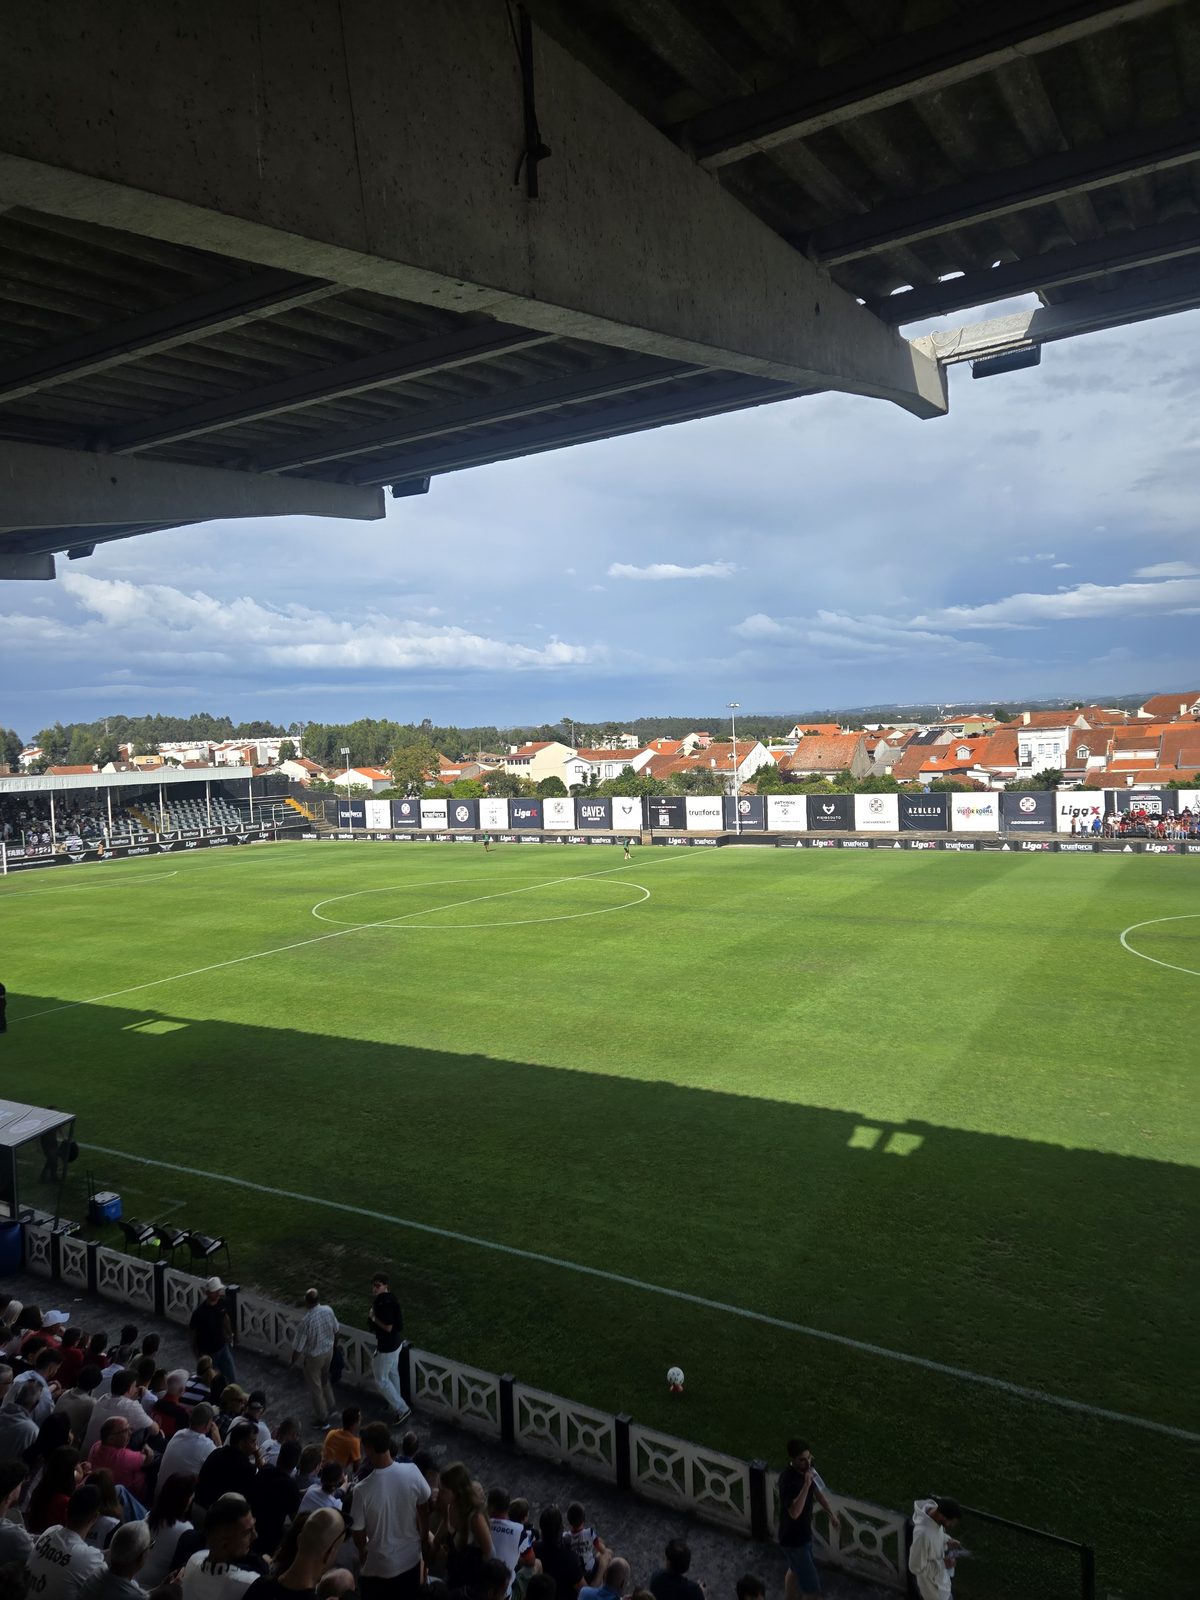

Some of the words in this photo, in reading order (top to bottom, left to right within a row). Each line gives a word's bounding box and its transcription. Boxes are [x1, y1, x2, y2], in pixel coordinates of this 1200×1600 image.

[514, 809, 537, 818] LigaX
[582, 806, 605, 817] GAVEX
[1061, 805, 1100, 816] LigaX
[1022, 842, 1049, 850] LigaX
[1146, 843, 1176, 853] LigaX
[36, 1536, 72, 1567] Chaos
